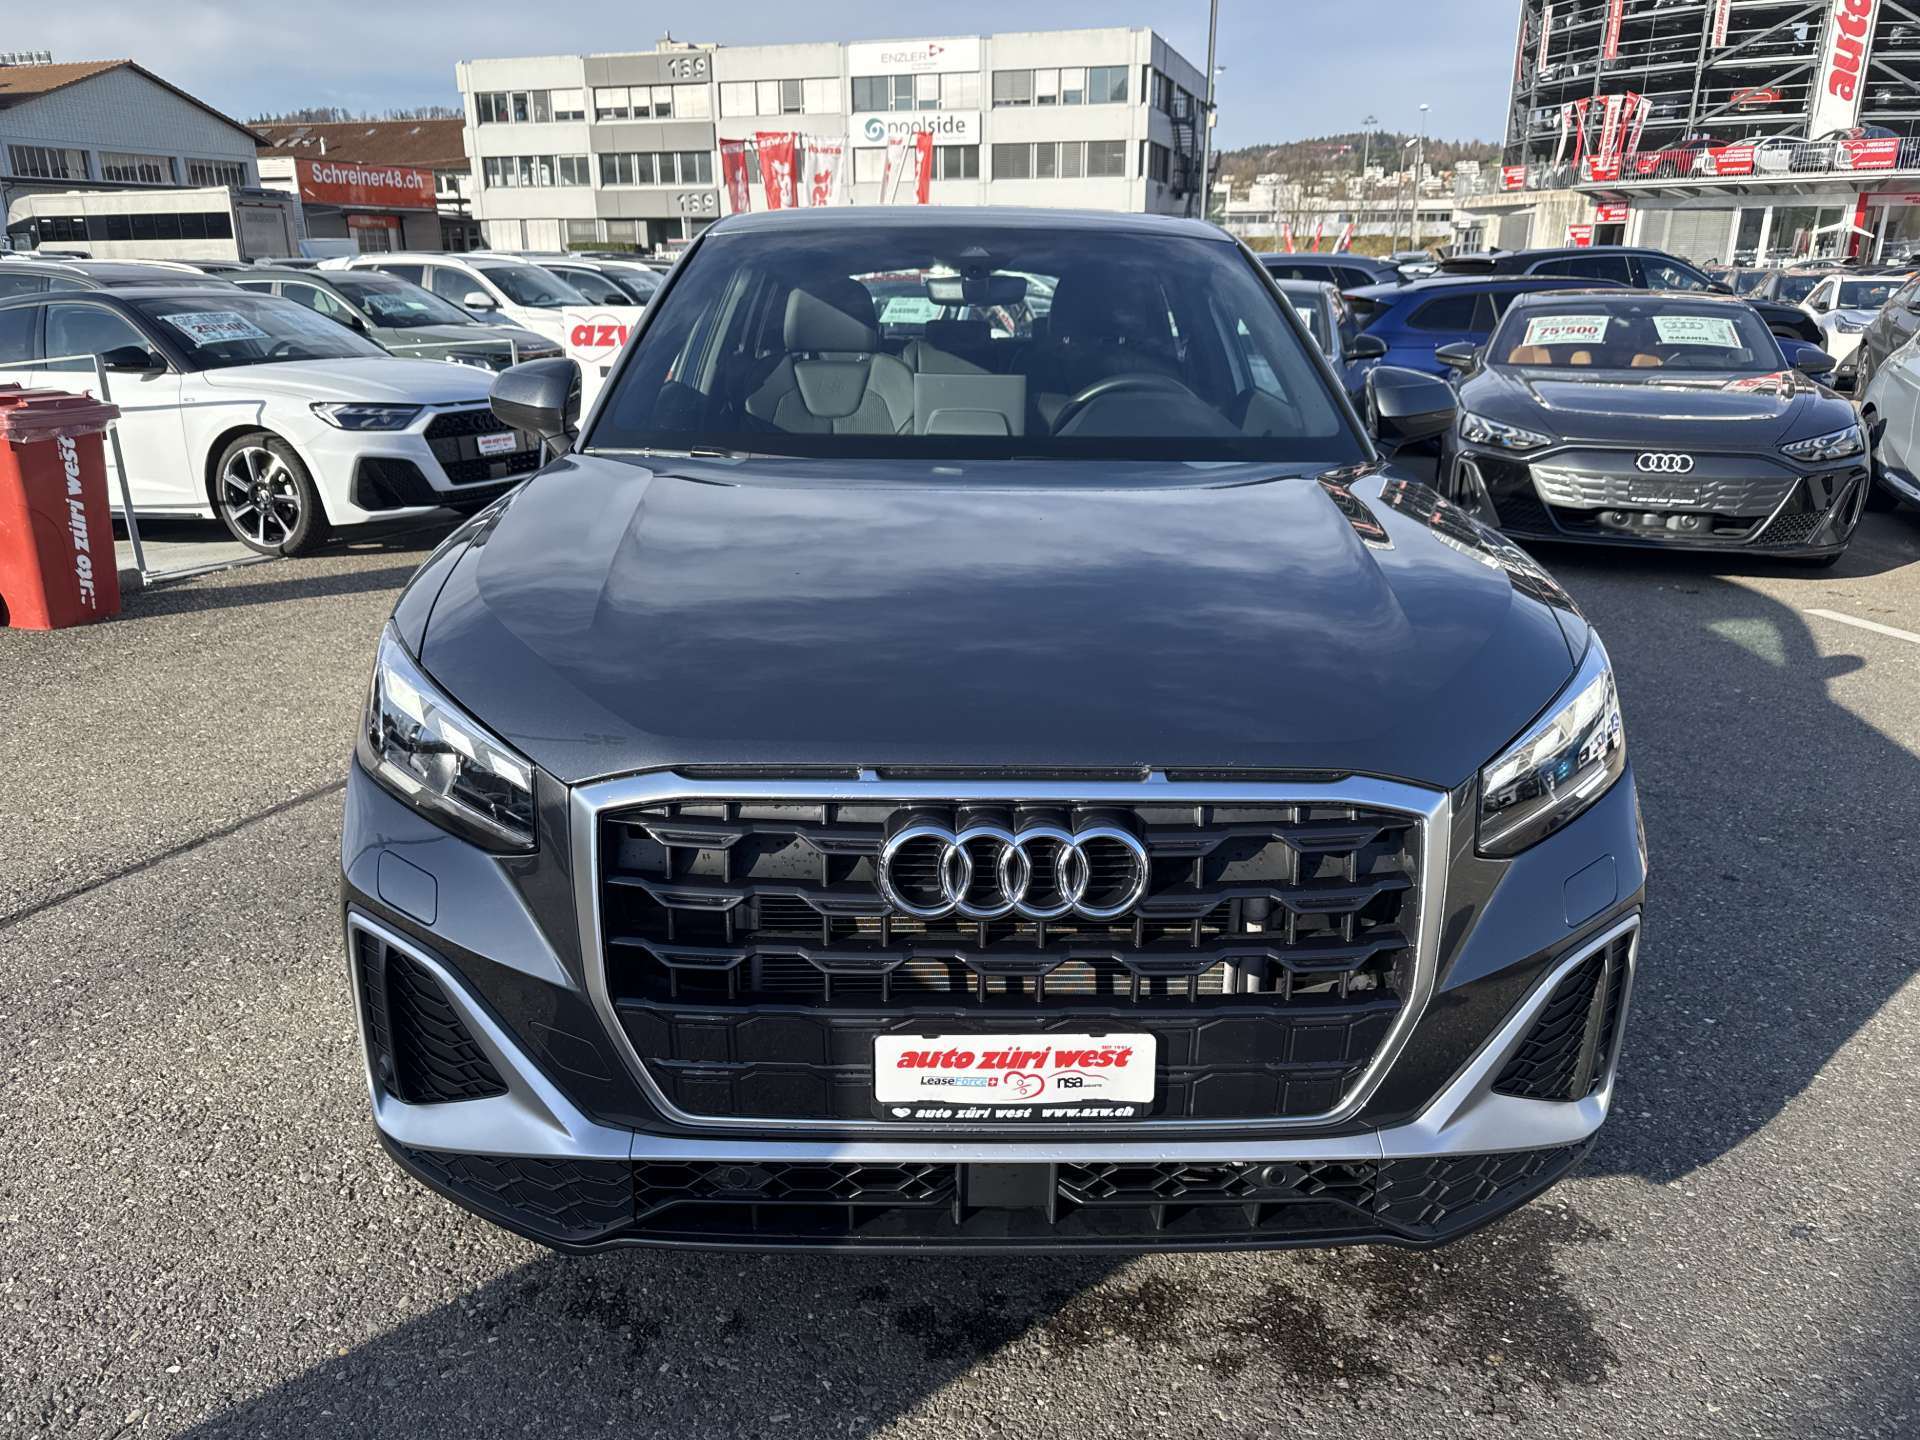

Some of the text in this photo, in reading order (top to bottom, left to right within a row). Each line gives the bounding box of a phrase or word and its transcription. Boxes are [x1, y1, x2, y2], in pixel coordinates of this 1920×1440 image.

[881, 52, 927, 63] ENZLER
[1829, 0, 1872, 101] auto
[667, 57, 706, 78] 139
[312, 163, 423, 189] Schreiner48.ch
[677, 193, 714, 212] 139
[1540, 326, 1598, 336] 75'500
[58, 434, 97, 610] uto züri west
[896, 1046, 1133, 1069] auto züri west
[920, 1076, 988, 1087] LeaseForce
[1057, 1077, 1083, 1088] nsa
[915, 1106, 1135, 1118] auto züri west www.azw.ch
